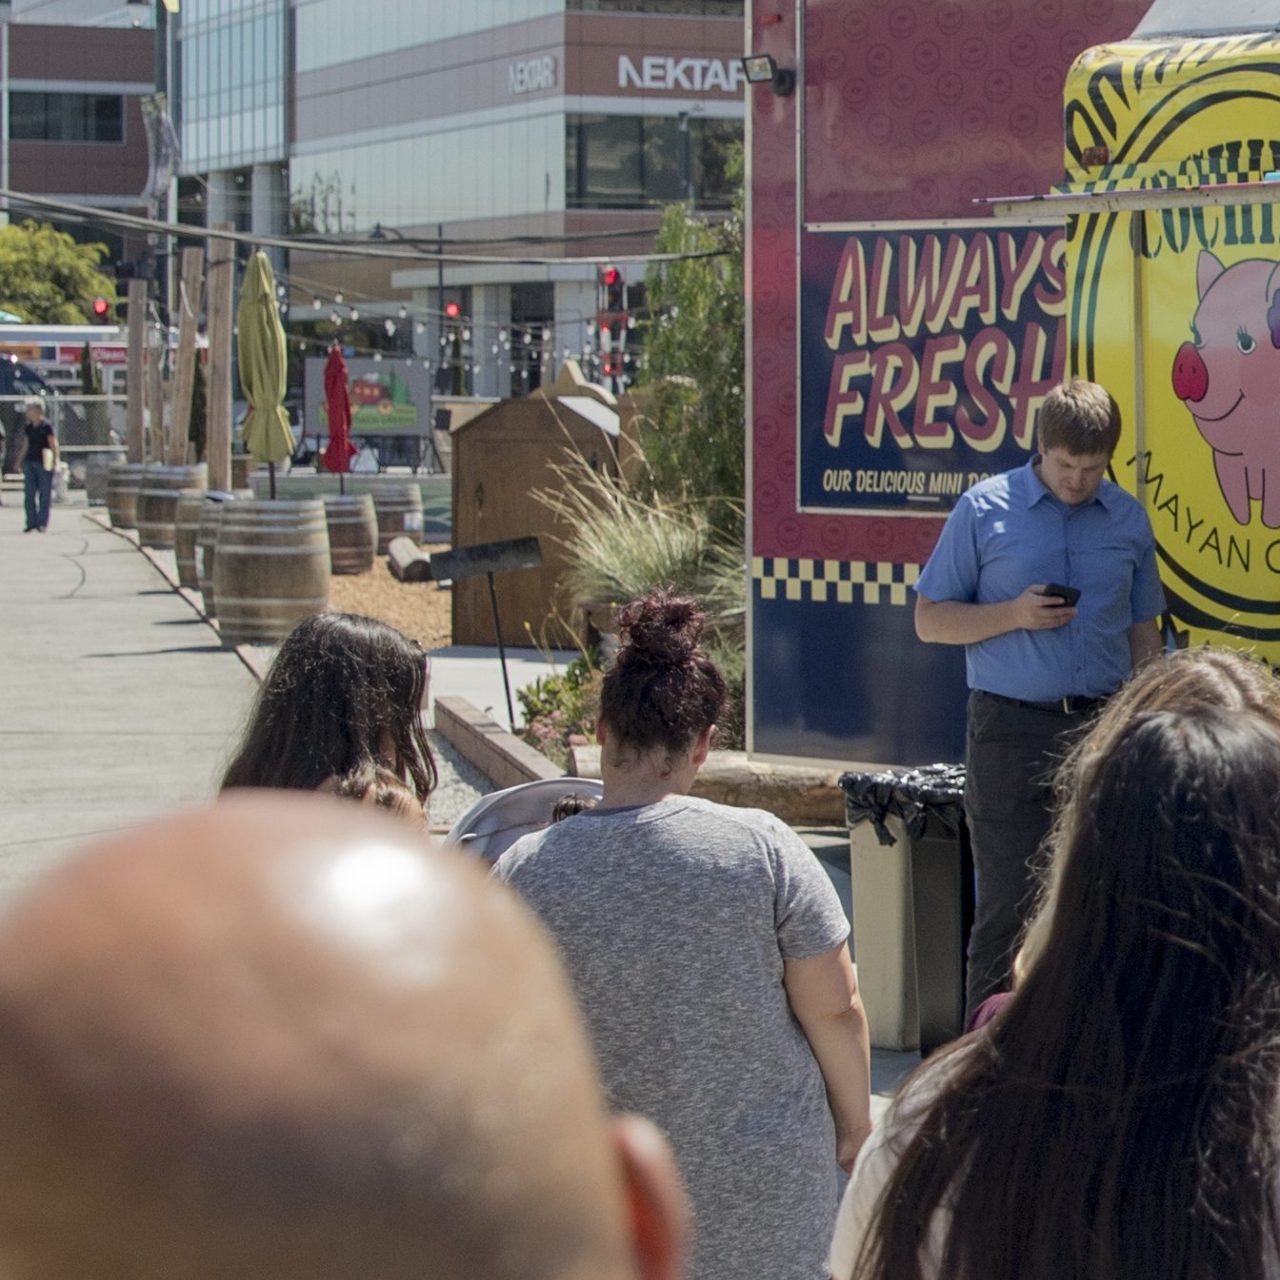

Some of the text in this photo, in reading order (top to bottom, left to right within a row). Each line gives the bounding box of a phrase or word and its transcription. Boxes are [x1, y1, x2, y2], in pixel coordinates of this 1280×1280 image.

[824, 230, 1067, 350] ALWAYS
[823, 317, 1067, 453] FRESH
[823, 469, 850, 492] OUR
[856, 469, 924, 494] DELICIOUS
[929, 471, 962, 495] MINI
[1126, 450, 1250, 573] MAYAN
